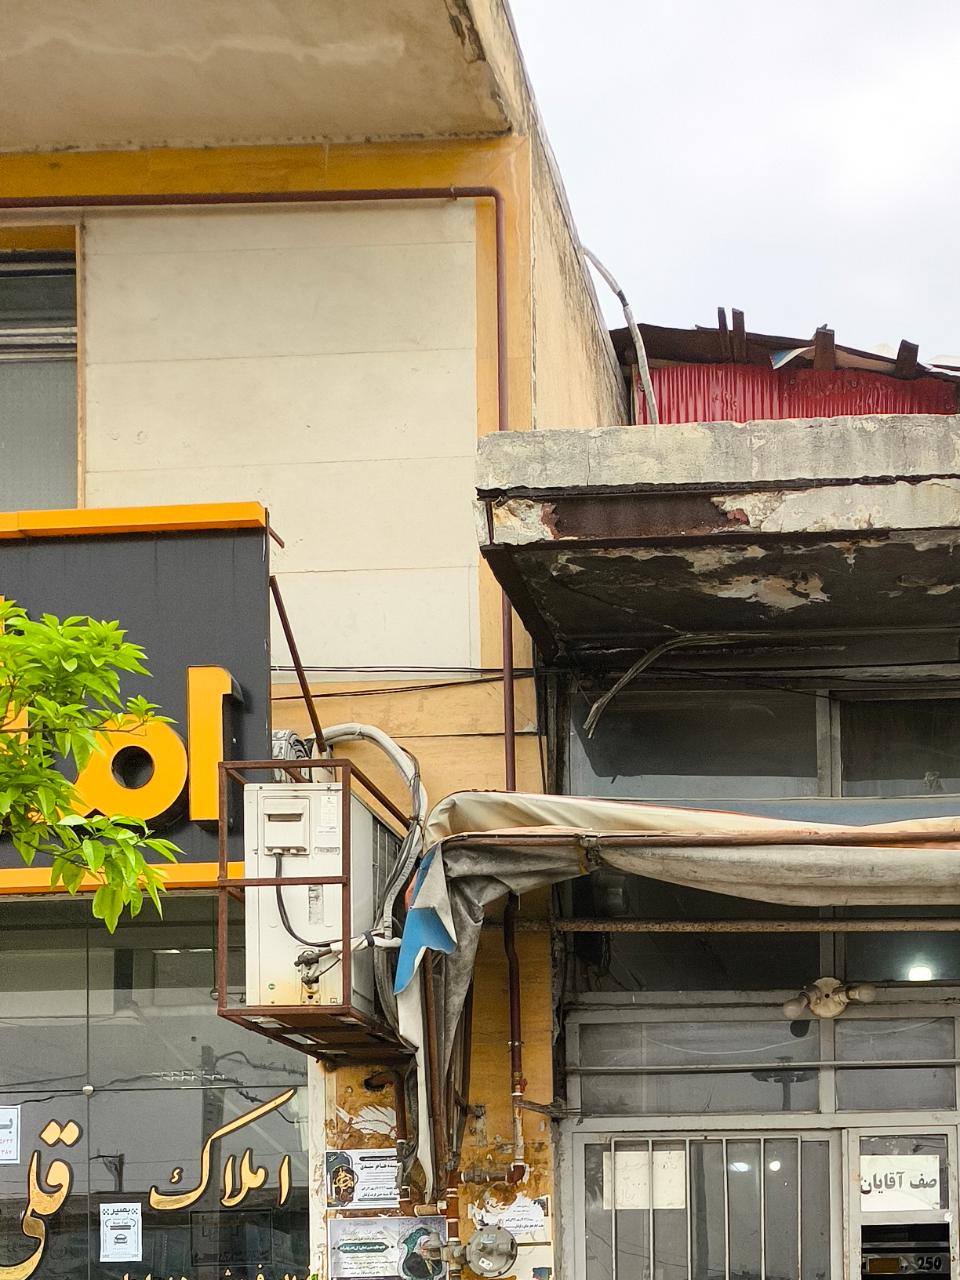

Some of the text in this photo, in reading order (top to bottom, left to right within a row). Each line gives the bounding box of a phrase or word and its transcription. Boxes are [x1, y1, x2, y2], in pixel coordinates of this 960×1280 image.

[860, 1171, 938, 1195] صف آقایان
[917, 1255, 943, 1271] 250
